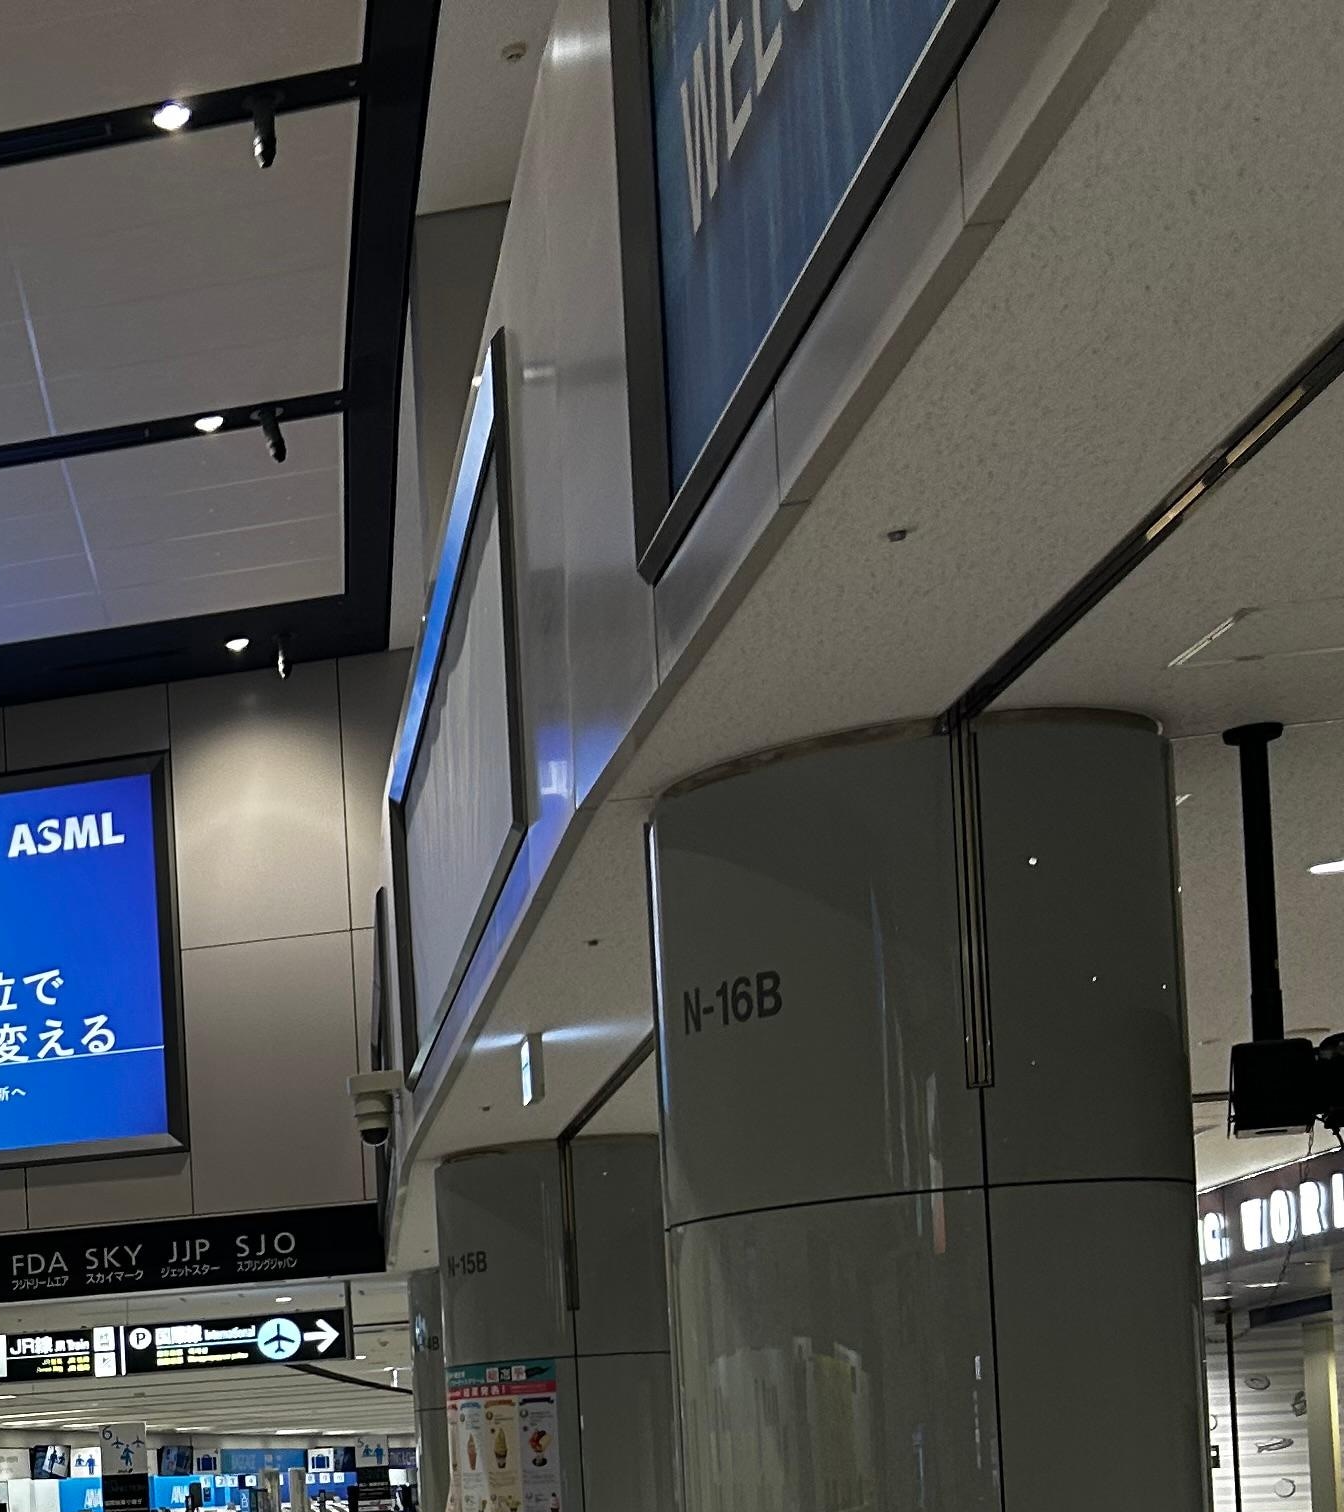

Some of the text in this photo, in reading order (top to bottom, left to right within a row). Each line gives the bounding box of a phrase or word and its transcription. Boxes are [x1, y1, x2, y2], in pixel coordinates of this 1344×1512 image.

[680, 0, 803, 236] WEL
[8, 811, 125, 858] ASML
[683, 970, 783, 1036] N-16B
[85, 1244, 143, 1270] SKY
[168, 1239, 210, 1263] JJP
[235, 1232, 296, 1257] SJO
[12, 1251, 69, 1276] FDA
[161, 1263, 221, 1278] ジェットスター
[447, 1251, 487, 1277] N-15B
[85, 1269, 144, 1285] スカイマーク
[102, 1426, 112, 1440] 6
